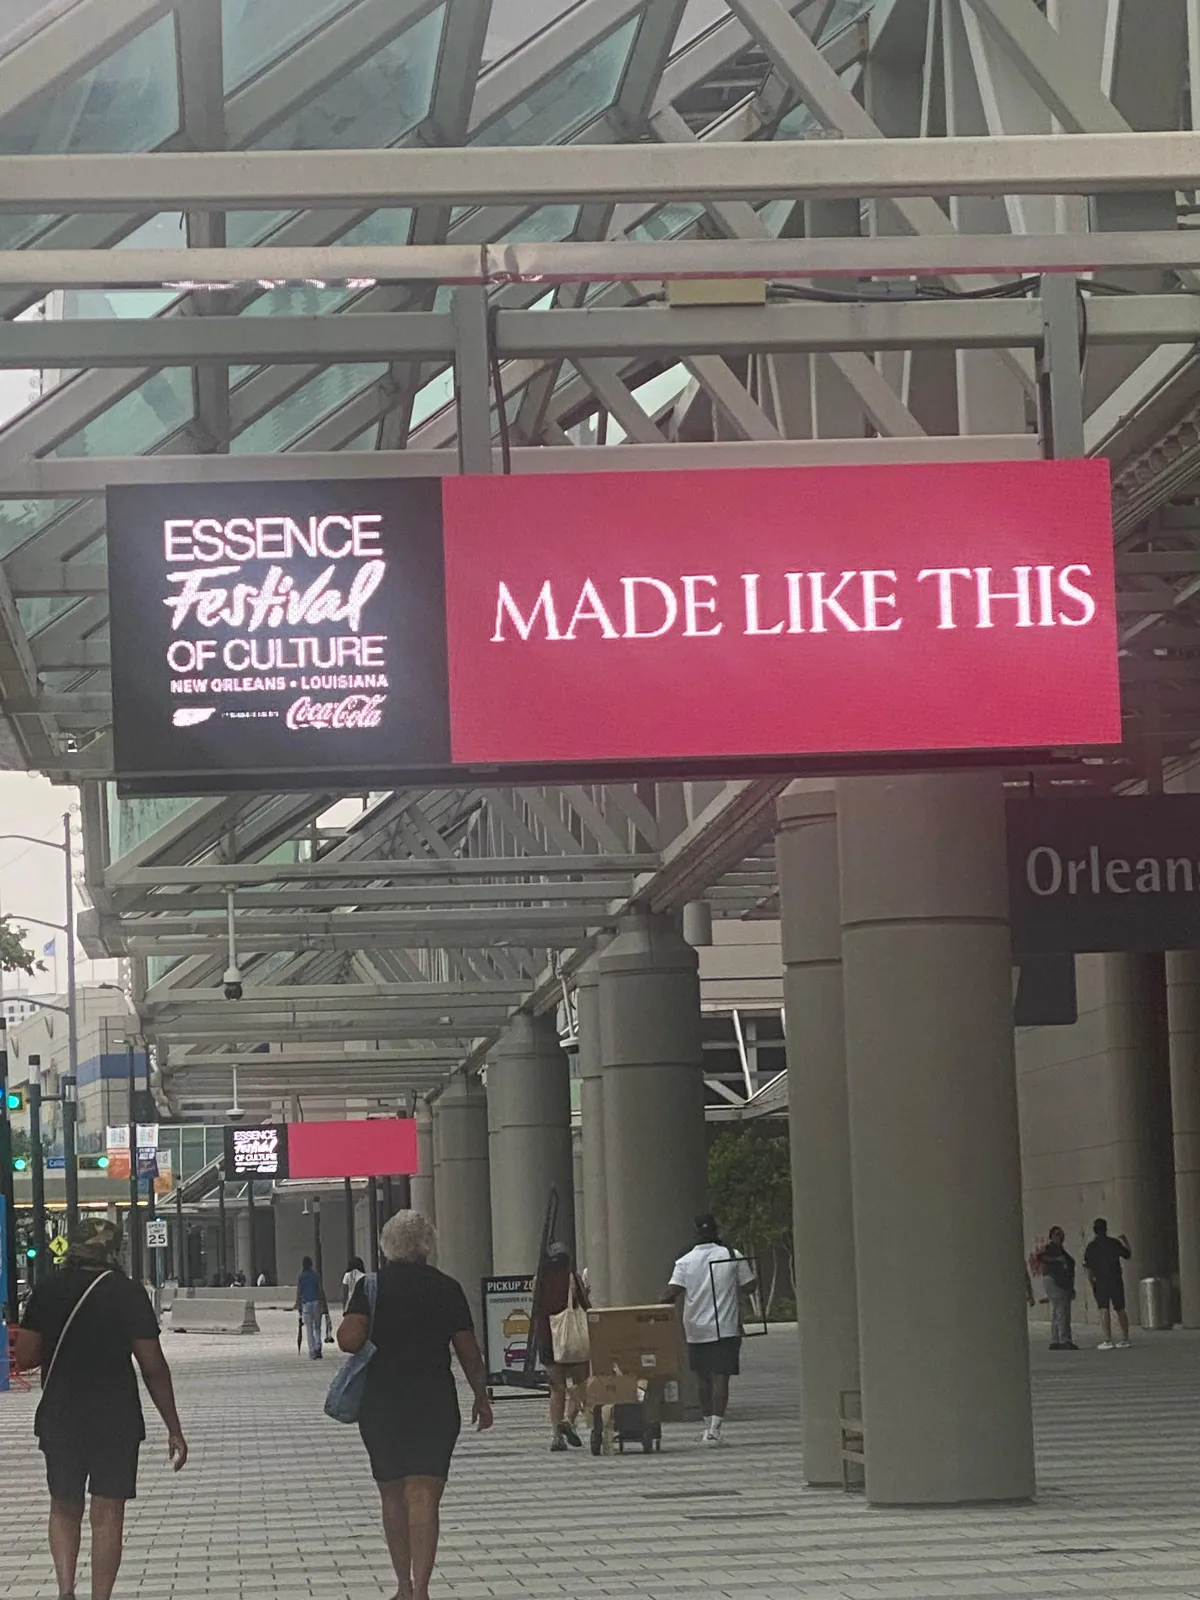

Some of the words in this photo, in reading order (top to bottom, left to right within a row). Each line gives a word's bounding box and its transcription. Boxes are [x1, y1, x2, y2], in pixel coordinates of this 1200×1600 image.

[163, 513, 384, 562] ESSENCE
[162, 559, 387, 632] Festival
[489, 573, 724, 643] MADE
[740, 568, 904, 637] LIKE
[916, 563, 1097, 630] THIS
[166, 639, 218, 673] OF
[222, 635, 388, 671] CULTURE
[170, 678, 208, 694] NEW
[210, 676, 286, 693] ORLEANS
[301, 673, 389, 690] LOUISIANA
[1026, 845, 1200, 896] Orlean
[233, 1130, 277, 1141] ESSENCE
[148, 1234, 166, 1245] 25
[487, 1281, 521, 1291] PICKUP
